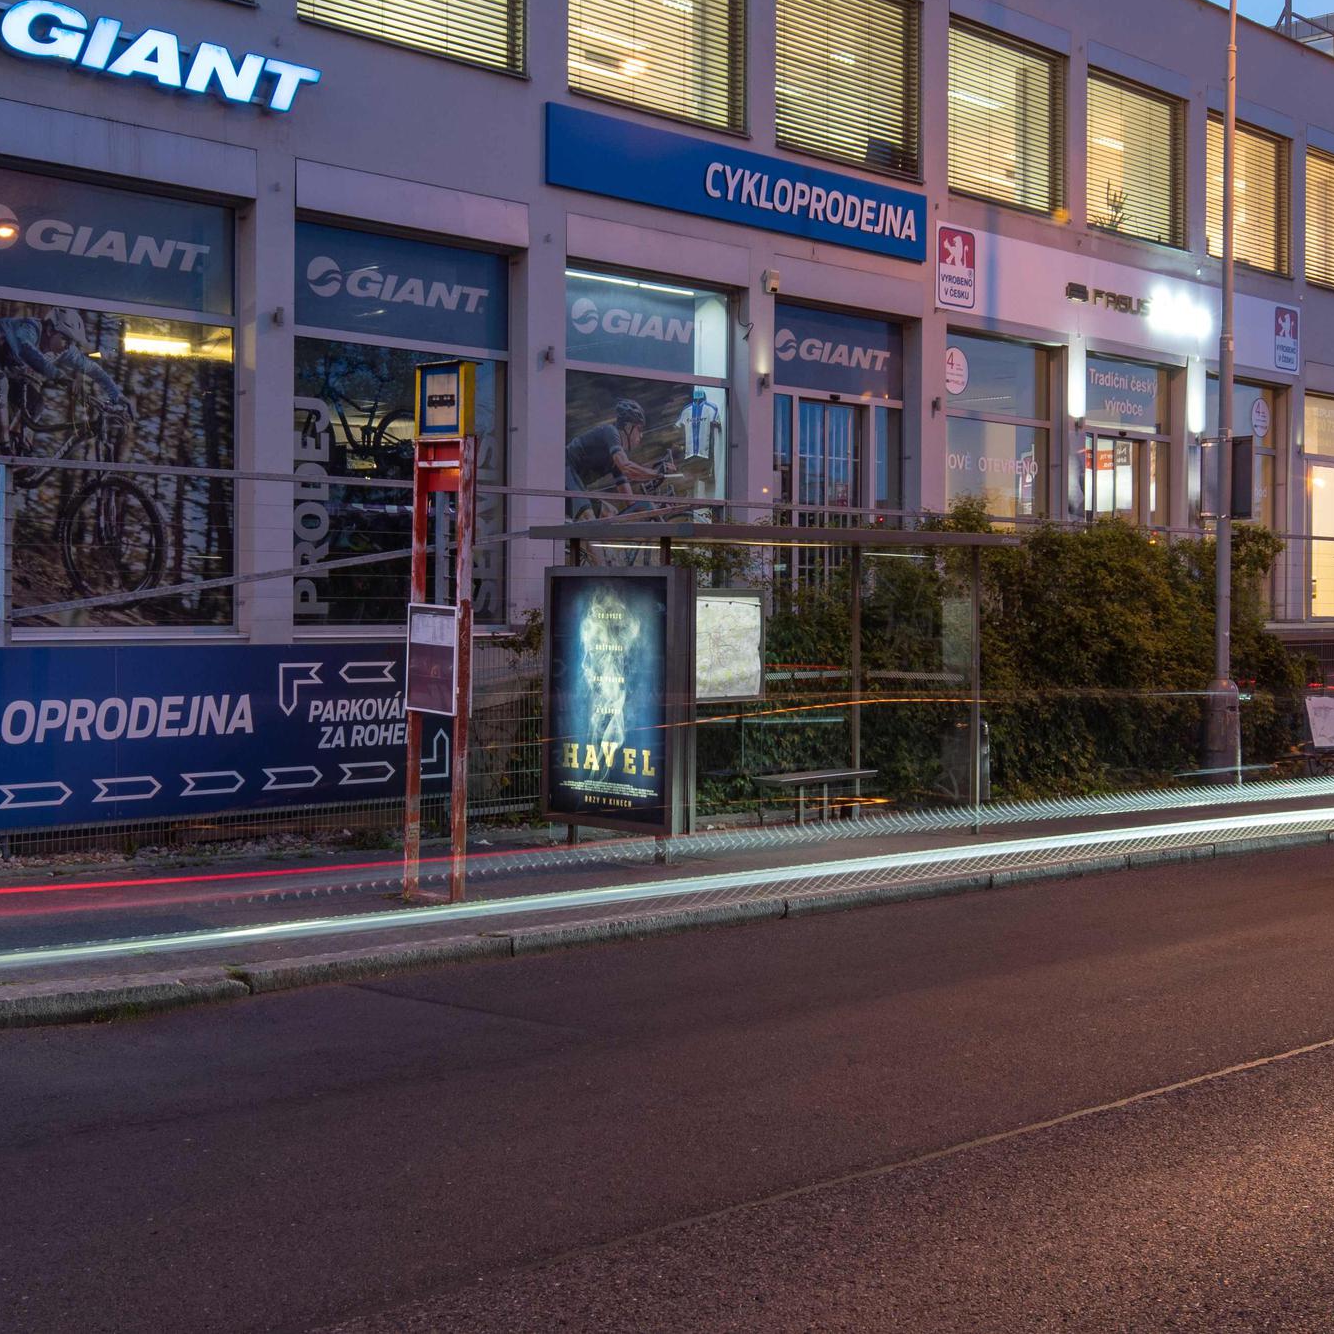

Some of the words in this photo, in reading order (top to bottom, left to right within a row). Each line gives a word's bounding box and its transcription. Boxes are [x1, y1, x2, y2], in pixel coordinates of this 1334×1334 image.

[705, 162, 917, 243] CYKLOPRODEJNA
[25, 218, 210, 273] GIANT
[346, 270, 488, 314] GIANT
[940, 274, 972, 287] VYROBENO
[944, 288, 948, 296] V
[949, 286, 969, 300] ČESKU
[602, 308, 695, 344] GIAN
[798, 338, 890, 370] GIANT
[1088, 367, 1128, 390] Tradiční
[1130, 374, 1158, 399] český
[1104, 395, 1143, 418] výrobce
[293, 396, 331, 615] PRODEJ
[471, 432, 498, 613] SEVIS
[318, 725, 346, 749] ZA
[562, 741, 656, 777] HAVEL
